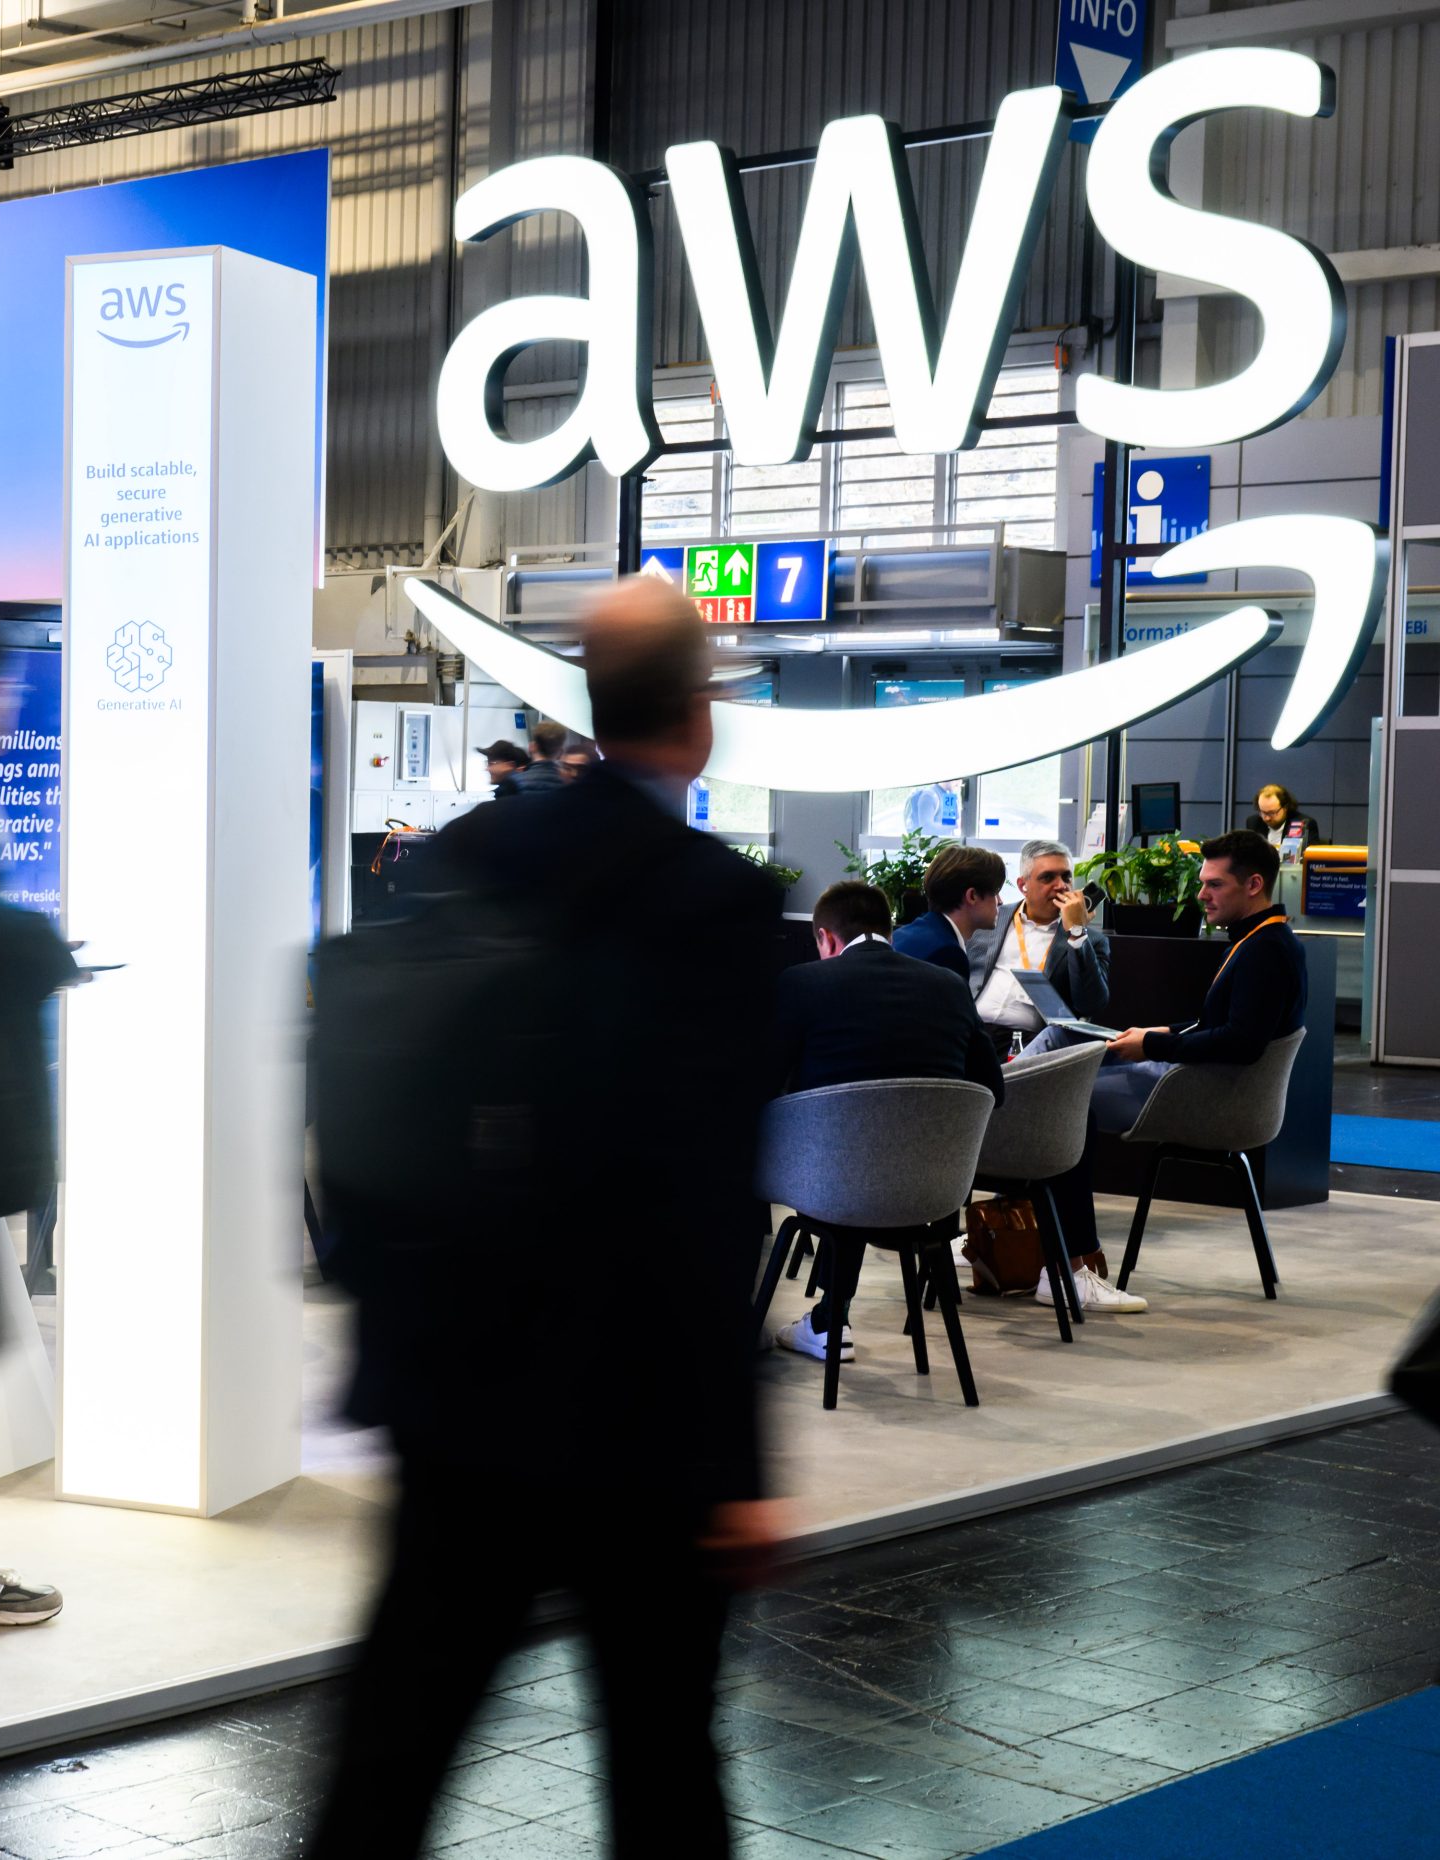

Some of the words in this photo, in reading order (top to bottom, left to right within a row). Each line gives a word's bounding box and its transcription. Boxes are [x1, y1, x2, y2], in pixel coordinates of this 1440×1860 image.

[1070, 0, 1137, 37] INFO
[436, 47, 1337, 493] aws
[99, 282, 187, 321] aws
[86, 463, 126, 479] Build
[130, 460, 197, 478] scalable,
[116, 488, 166, 501] secure
[100, 506, 182, 528] generative
[83, 533, 100, 547] AI
[104, 529, 200, 550] applications
[777, 556, 803, 603] 7
[97, 698, 165, 711] Generative
[169, 698, 182, 711] AI
